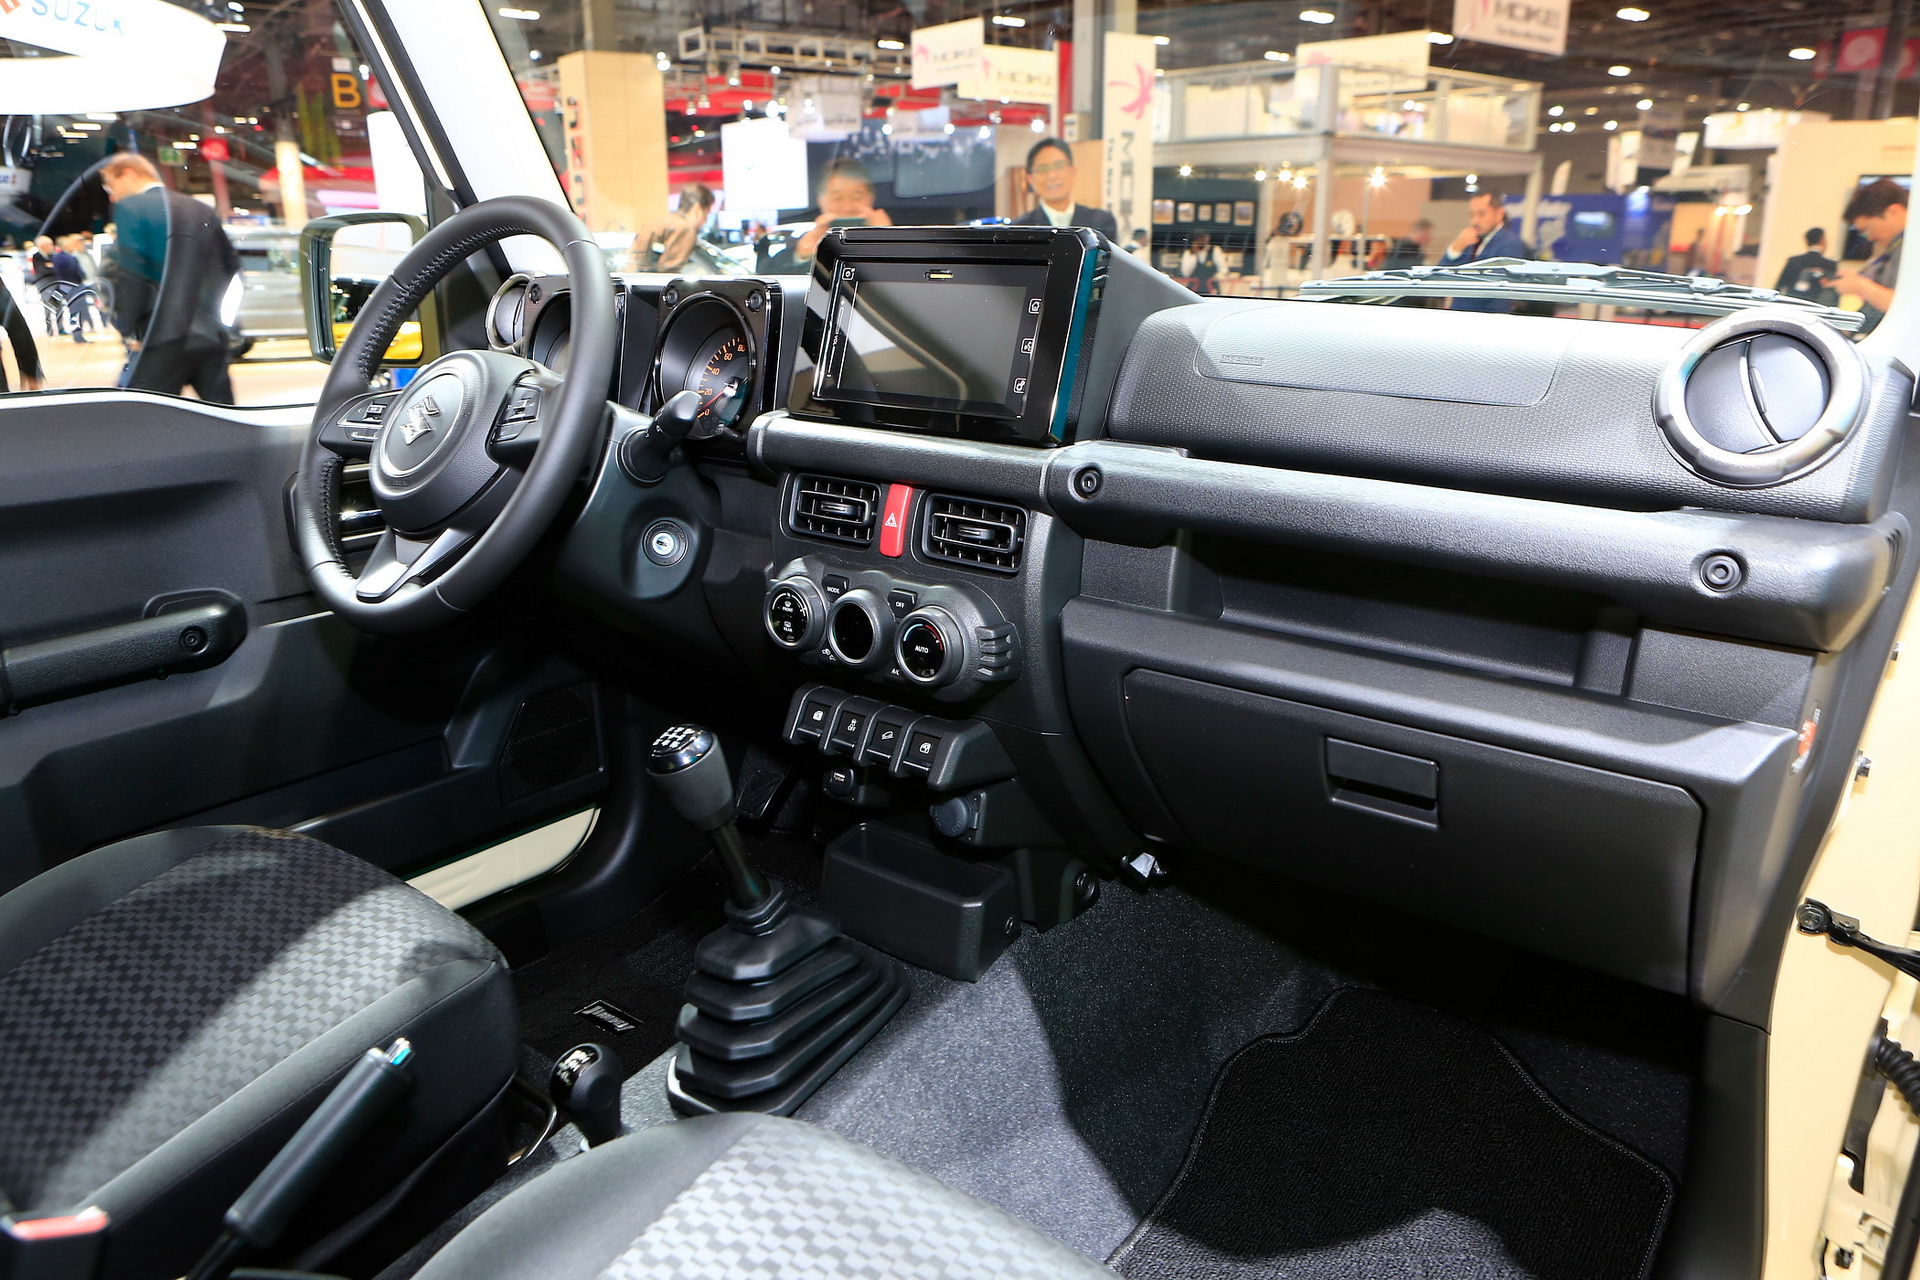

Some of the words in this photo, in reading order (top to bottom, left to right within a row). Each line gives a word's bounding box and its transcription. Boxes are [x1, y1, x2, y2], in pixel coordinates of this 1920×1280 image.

[331, 72, 361, 108] B
[723, 352, 733, 361] 60
[711, 368, 721, 376] 40
[704, 388, 713, 396] 20
[826, 586, 840, 594] MODE
[895, 601, 905, 609] OFF
[914, 645, 929, 654] AUTO
